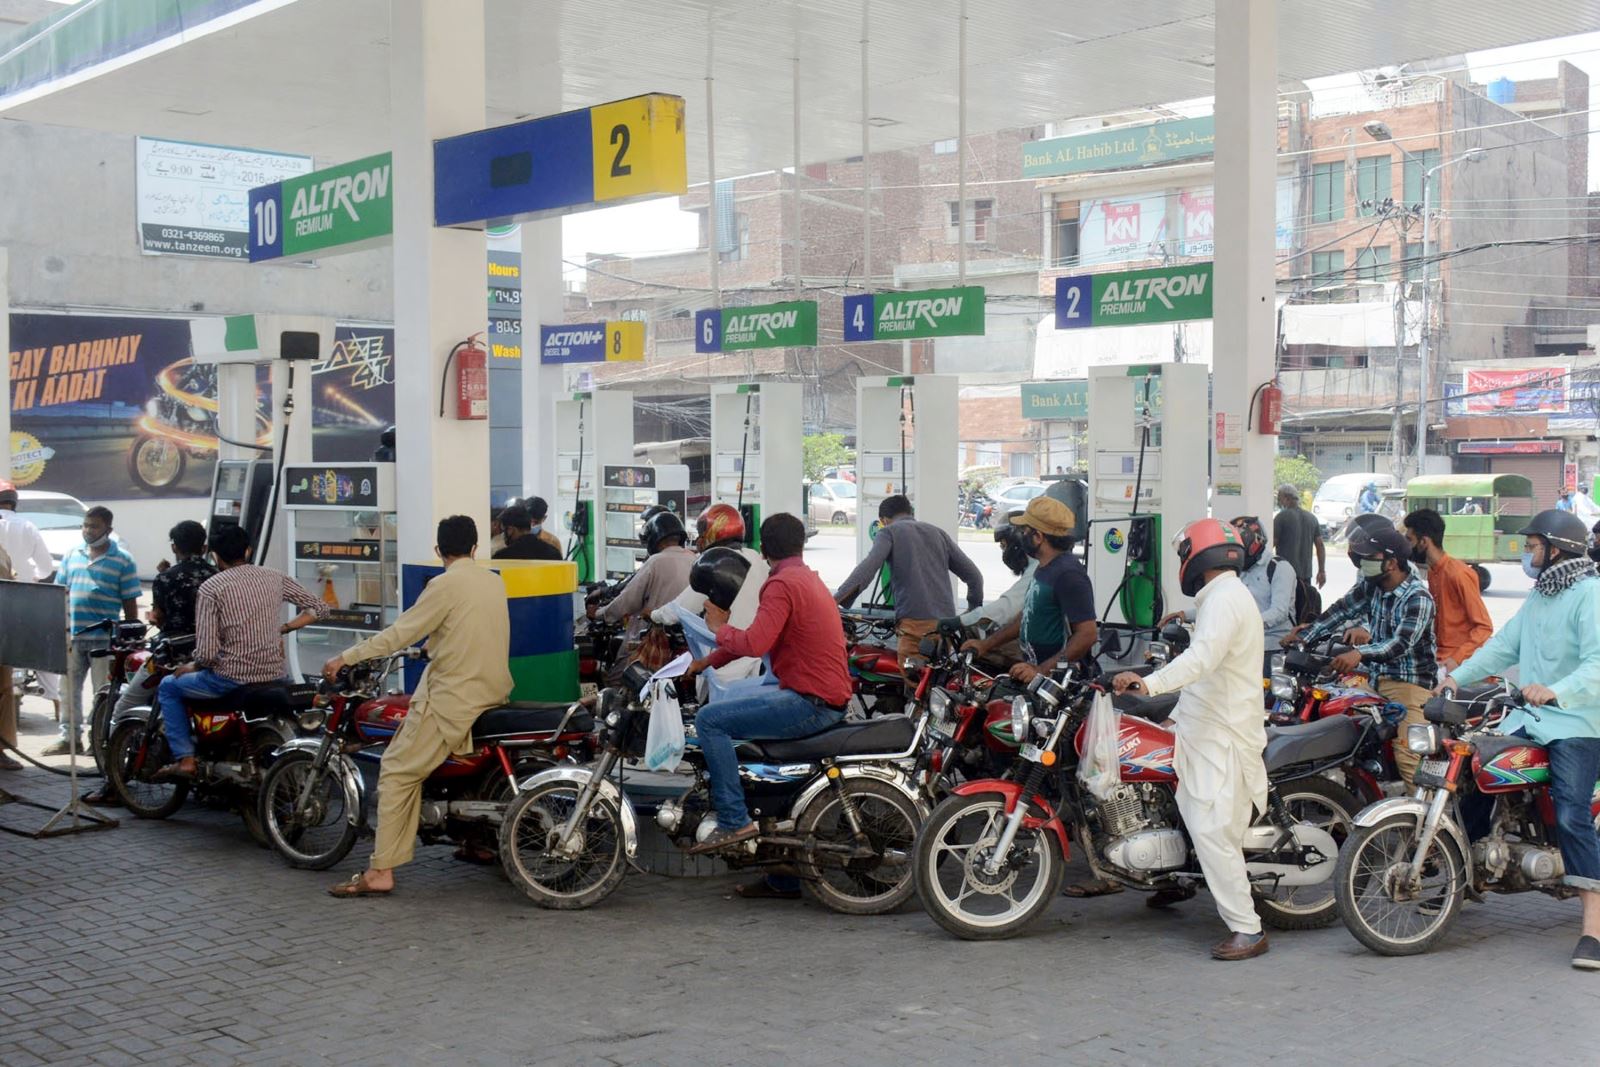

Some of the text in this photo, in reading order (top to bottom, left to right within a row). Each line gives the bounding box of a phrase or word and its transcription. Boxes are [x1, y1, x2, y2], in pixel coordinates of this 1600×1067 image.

[610, 123, 631, 178] 2
[1024, 138, 1138, 168] Bank AL Habib Ltd.
[171, 165, 193, 176] 9:00
[255, 198, 277, 247] 10
[289, 165, 390, 222] ALTRON
[295, 213, 334, 237] REMIUM
[1106, 215, 1138, 241] KN
[145, 239, 242, 257] www.tanzeem.org
[488, 263, 519, 277] Hours
[1067, 273, 1208, 318] 2 ALTRON
[853, 296, 963, 332] 4 ALTRON
[1100, 301, 1146, 316] PREMIUM
[703, 310, 798, 344] 6 ALTRON
[725, 331, 757, 344] PREMIUM
[879, 319, 915, 333] PREMIUM
[492, 343, 522, 358] Wash
[544, 330, 621, 354] ACTION+ 8
[48, 334, 143, 375] BARHNAY
[13, 369, 107, 411] KI AADAT
[1031, 394, 1060, 407] Bank
[1119, 736, 1141, 757] ZUKI
